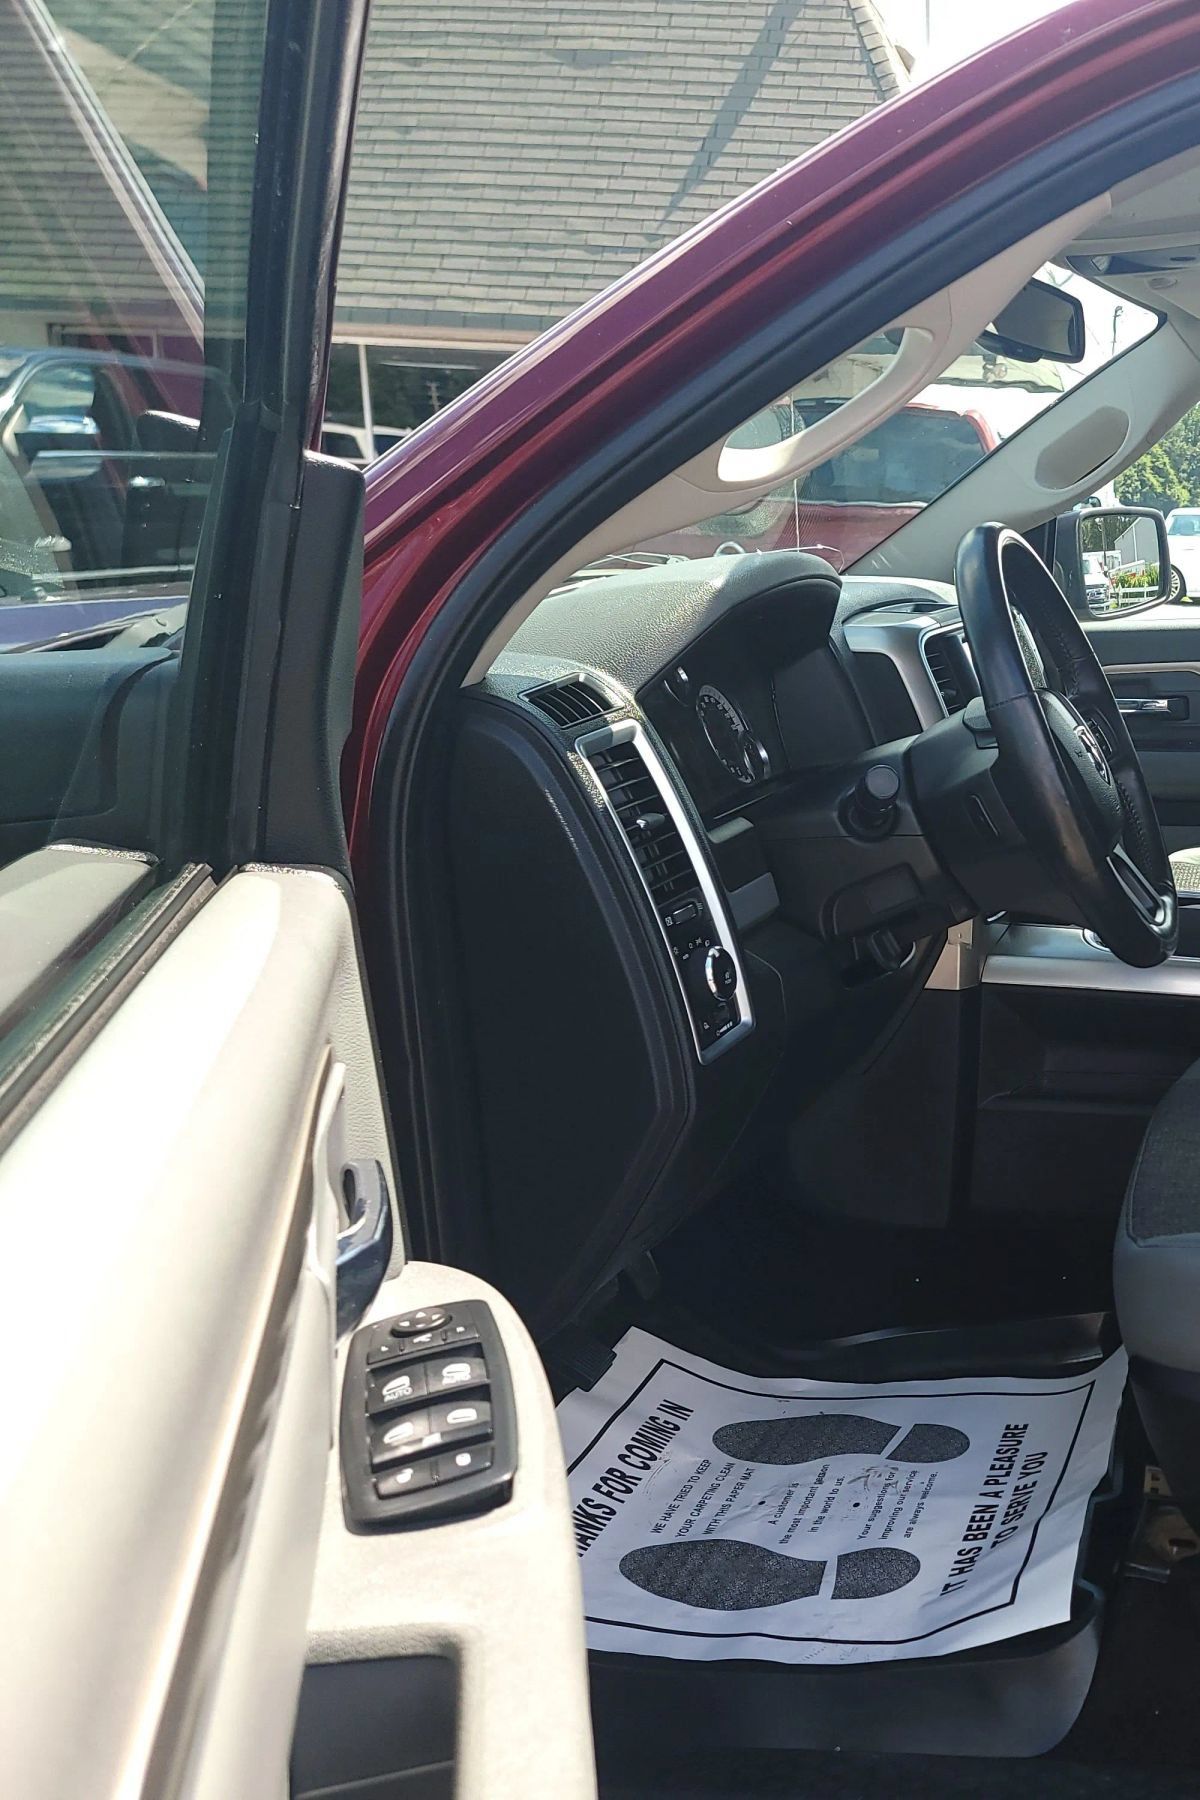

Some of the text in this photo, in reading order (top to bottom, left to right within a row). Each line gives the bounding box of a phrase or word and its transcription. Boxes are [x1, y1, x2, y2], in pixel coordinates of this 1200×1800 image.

[384, 1387, 413, 1402] AUTO
[572, 1399, 694, 1557] ANKS FOR COMING IN
[650, 1459, 712, 1534] WE HAVE TRIED TO KEEP
[675, 1462, 736, 1538] YOUR CARPETING CLEAN
[702, 1468, 756, 1535] WITH THIS PAPER MAT
[774, 1489, 795, 1519] customer
[778, 1464, 830, 1544] the most important person
[813, 1515, 825, 1525] the
[820, 1496, 836, 1514] world
[834, 1476, 845, 1486] us.
[856, 1471, 896, 1540] Your suggestions for
[878, 1470, 919, 1540] improving our service
[904, 1472, 938, 1538] are always welcome.
[940, 1423, 1029, 1596] IT HAS BEEN A PLEASURE
[991, 1451, 1049, 1549] TO SERVE YOU
